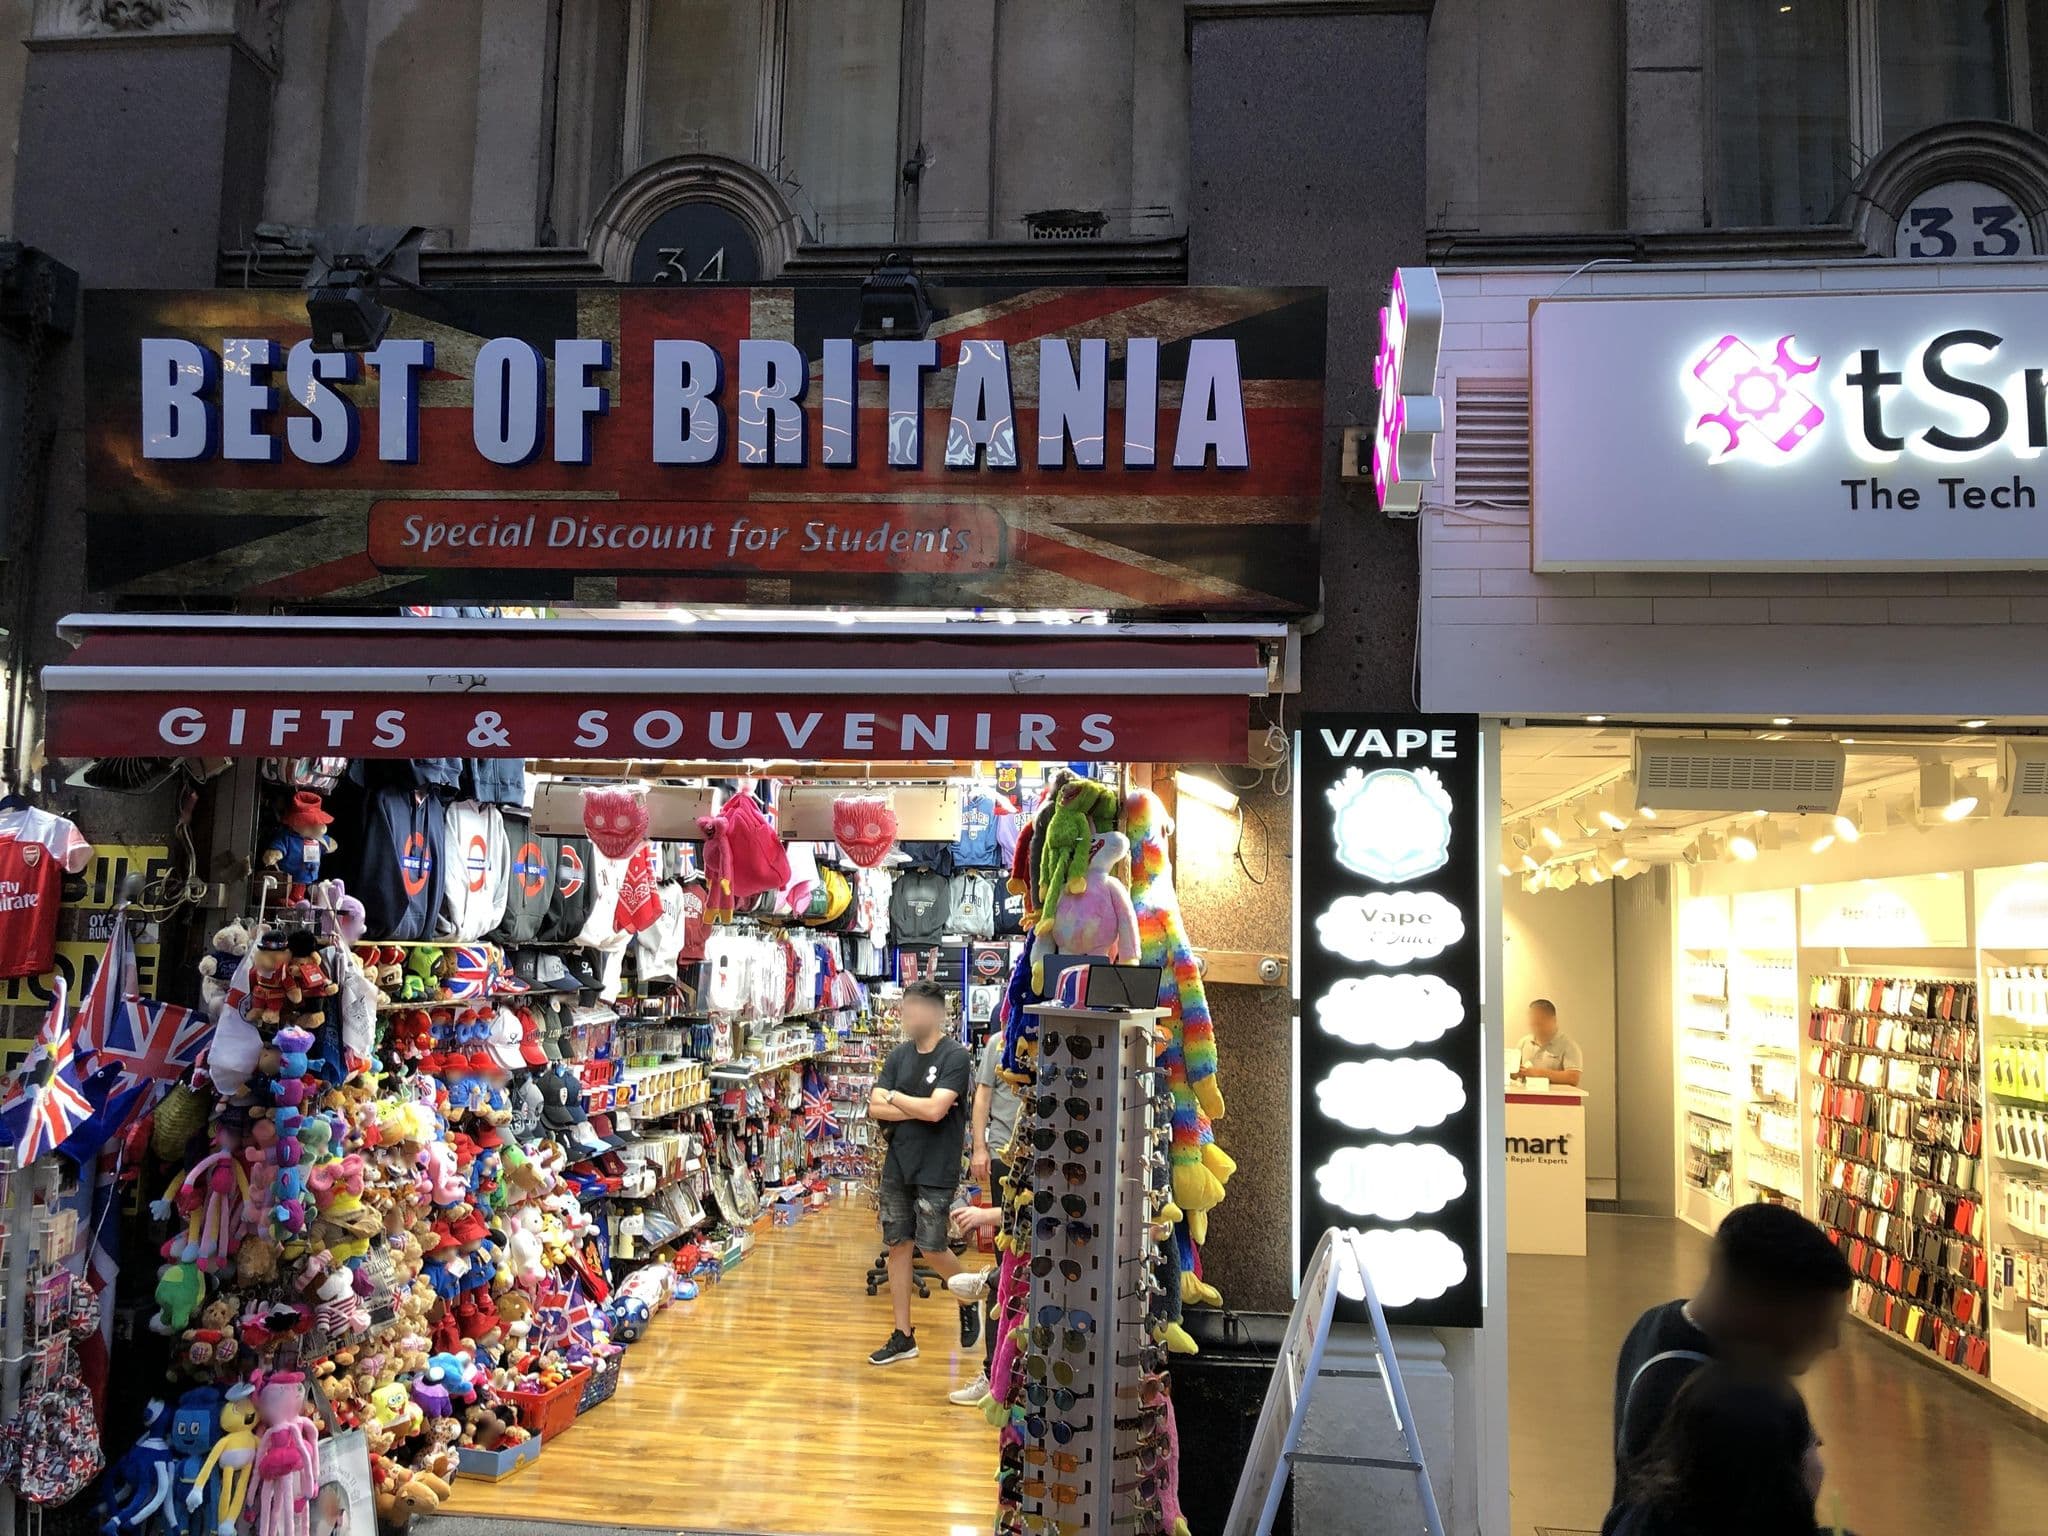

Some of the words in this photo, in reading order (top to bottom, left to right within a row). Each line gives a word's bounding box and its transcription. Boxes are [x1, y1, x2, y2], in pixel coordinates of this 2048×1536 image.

[1910, 206, 2020, 257] 33
[653, 246, 730, 282] 34
[142, 337, 430, 465] BEST
[472, 336, 612, 466] OF
[653, 336, 1250, 470] BRITANIA
[1841, 477, 1920, 510] The
[1938, 475, 2036, 510] Tech
[401, 514, 536, 552] Special
[547, 515, 715, 549] Discount
[727, 519, 788, 558] for
[801, 522, 972, 552] Students
[158, 707, 406, 749] GIFTS
[466, 710, 512, 748] &
[574, 709, 1116, 753] SOUVENIRS
[1320, 728, 1457, 759] VAPE
[1361, 908, 1433, 926] Vape
[1505, 1135, 1568, 1155] mart
[1510, 1155, 1536, 1164] Repair
[1537, 1157, 1569, 1165] Experts
